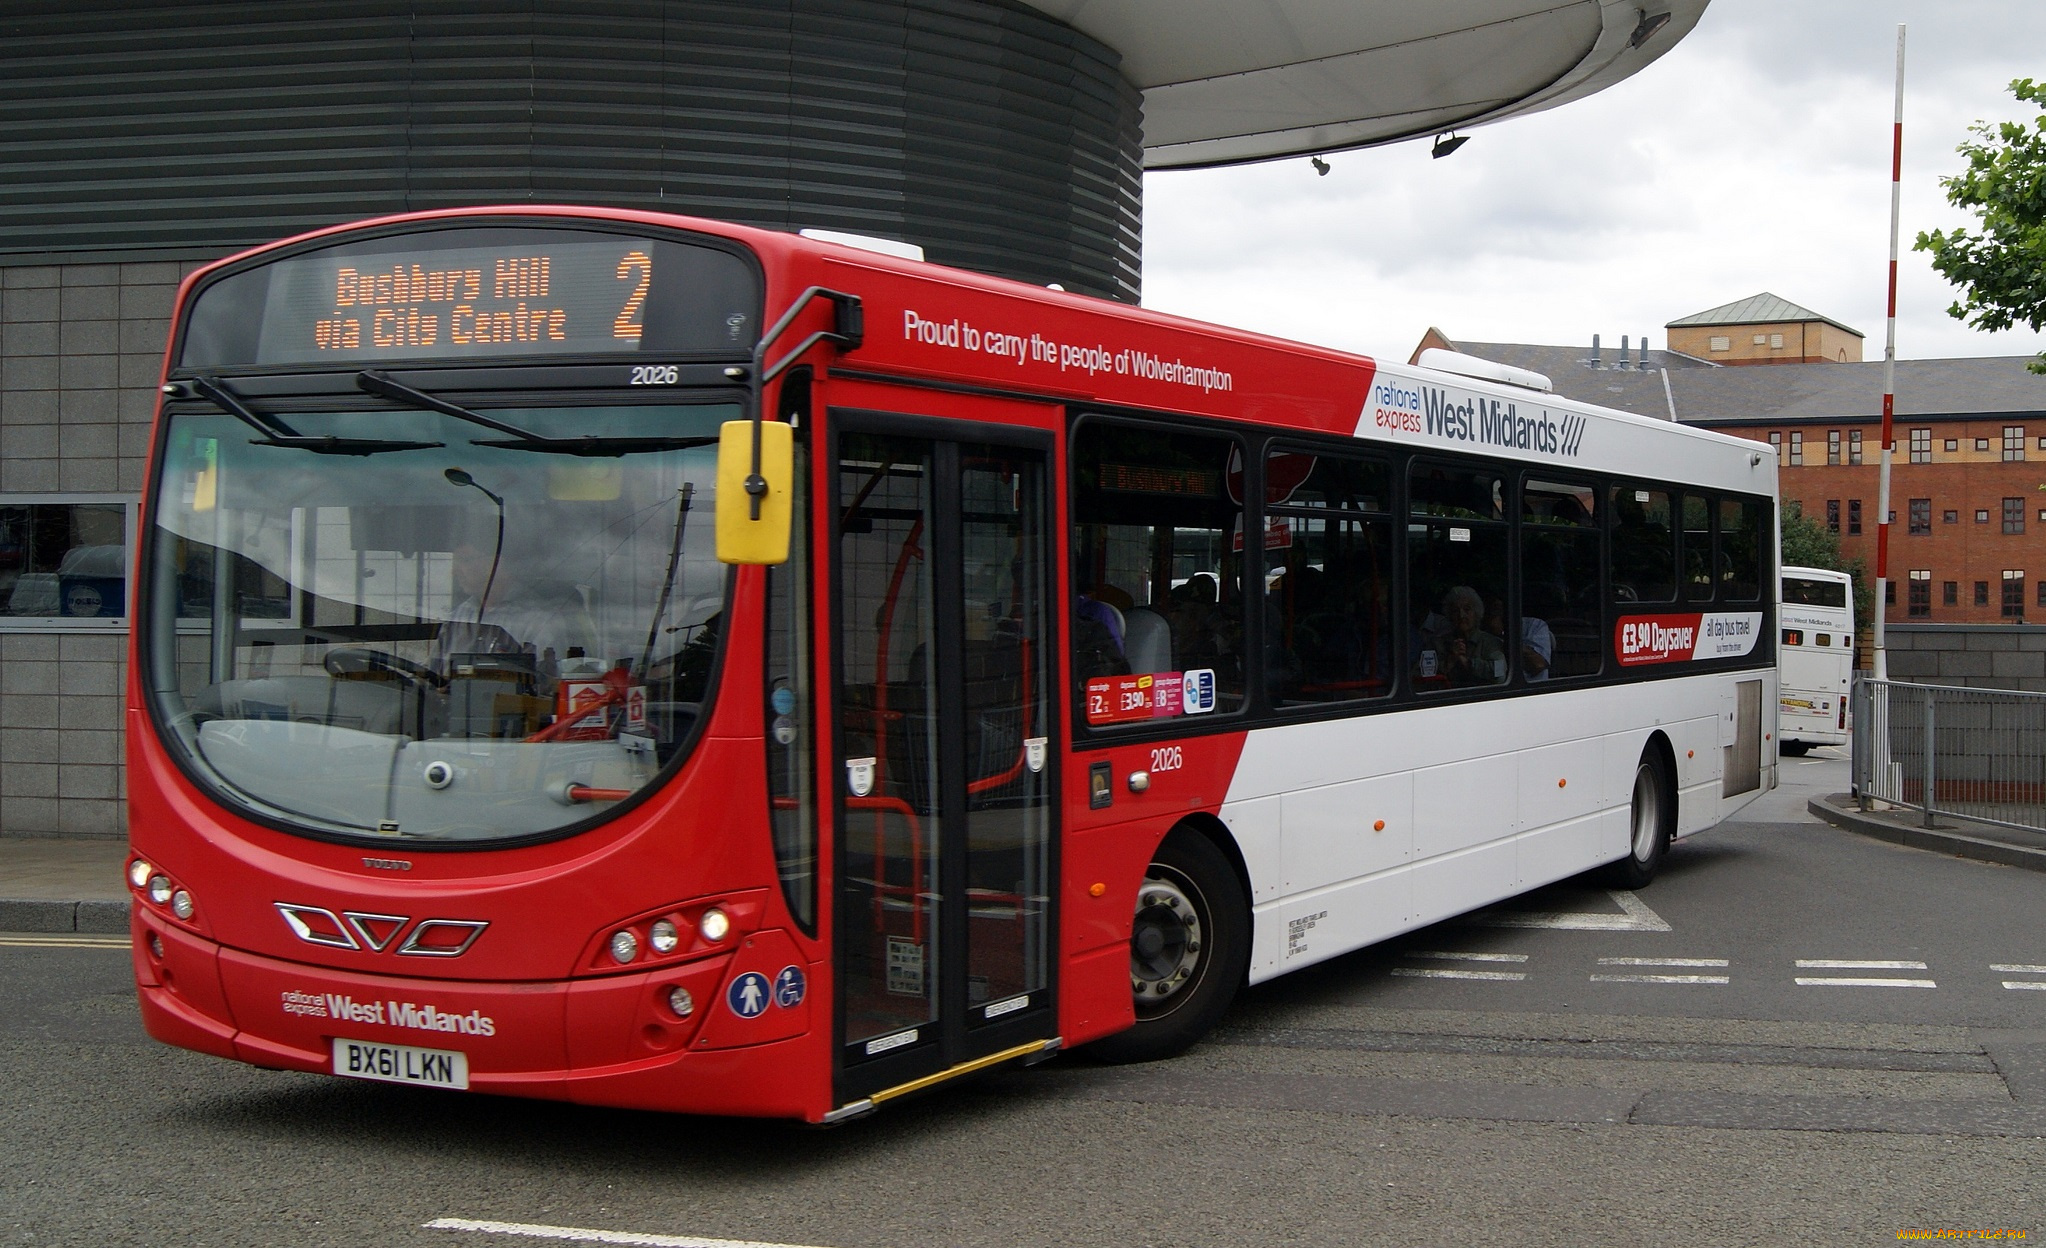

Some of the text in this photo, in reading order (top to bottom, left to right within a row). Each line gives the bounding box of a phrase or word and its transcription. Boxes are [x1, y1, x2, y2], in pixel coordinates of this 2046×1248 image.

[336, 257, 550, 306] Bushbury Hill
[613, 251, 652, 340] 2
[315, 302, 566, 350] via City Centre
[904, 310, 1233, 393] Proud to carry the people of Wolverhampton
[631, 366, 679, 385] 2026
[1375, 381, 1421, 411] national
[1375, 408, 1422, 436] express
[1422, 386, 1557, 454] West Midlands
[1714, 618, 1724, 640] day
[1725, 617, 1735, 636] bus
[1735, 617, 1750, 635] travel
[1808, 618, 1832, 626] Midlands
[1622, 621, 1693, 658] £3.90 Daysaver
[1788, 632, 1798, 645] 11
[1090, 695, 1103, 714] £2
[1120, 691, 1144, 711] £3.90
[1155, 690, 1167, 707] £8
[1150, 746, 1183, 773] 2026
[361, 857, 413, 871] VOLVO
[281, 989, 325, 1007] national
[282, 1001, 328, 1017] express
[326, 993, 496, 1037] West Midlands
[348, 1044, 453, 1083] BX61 LKN
